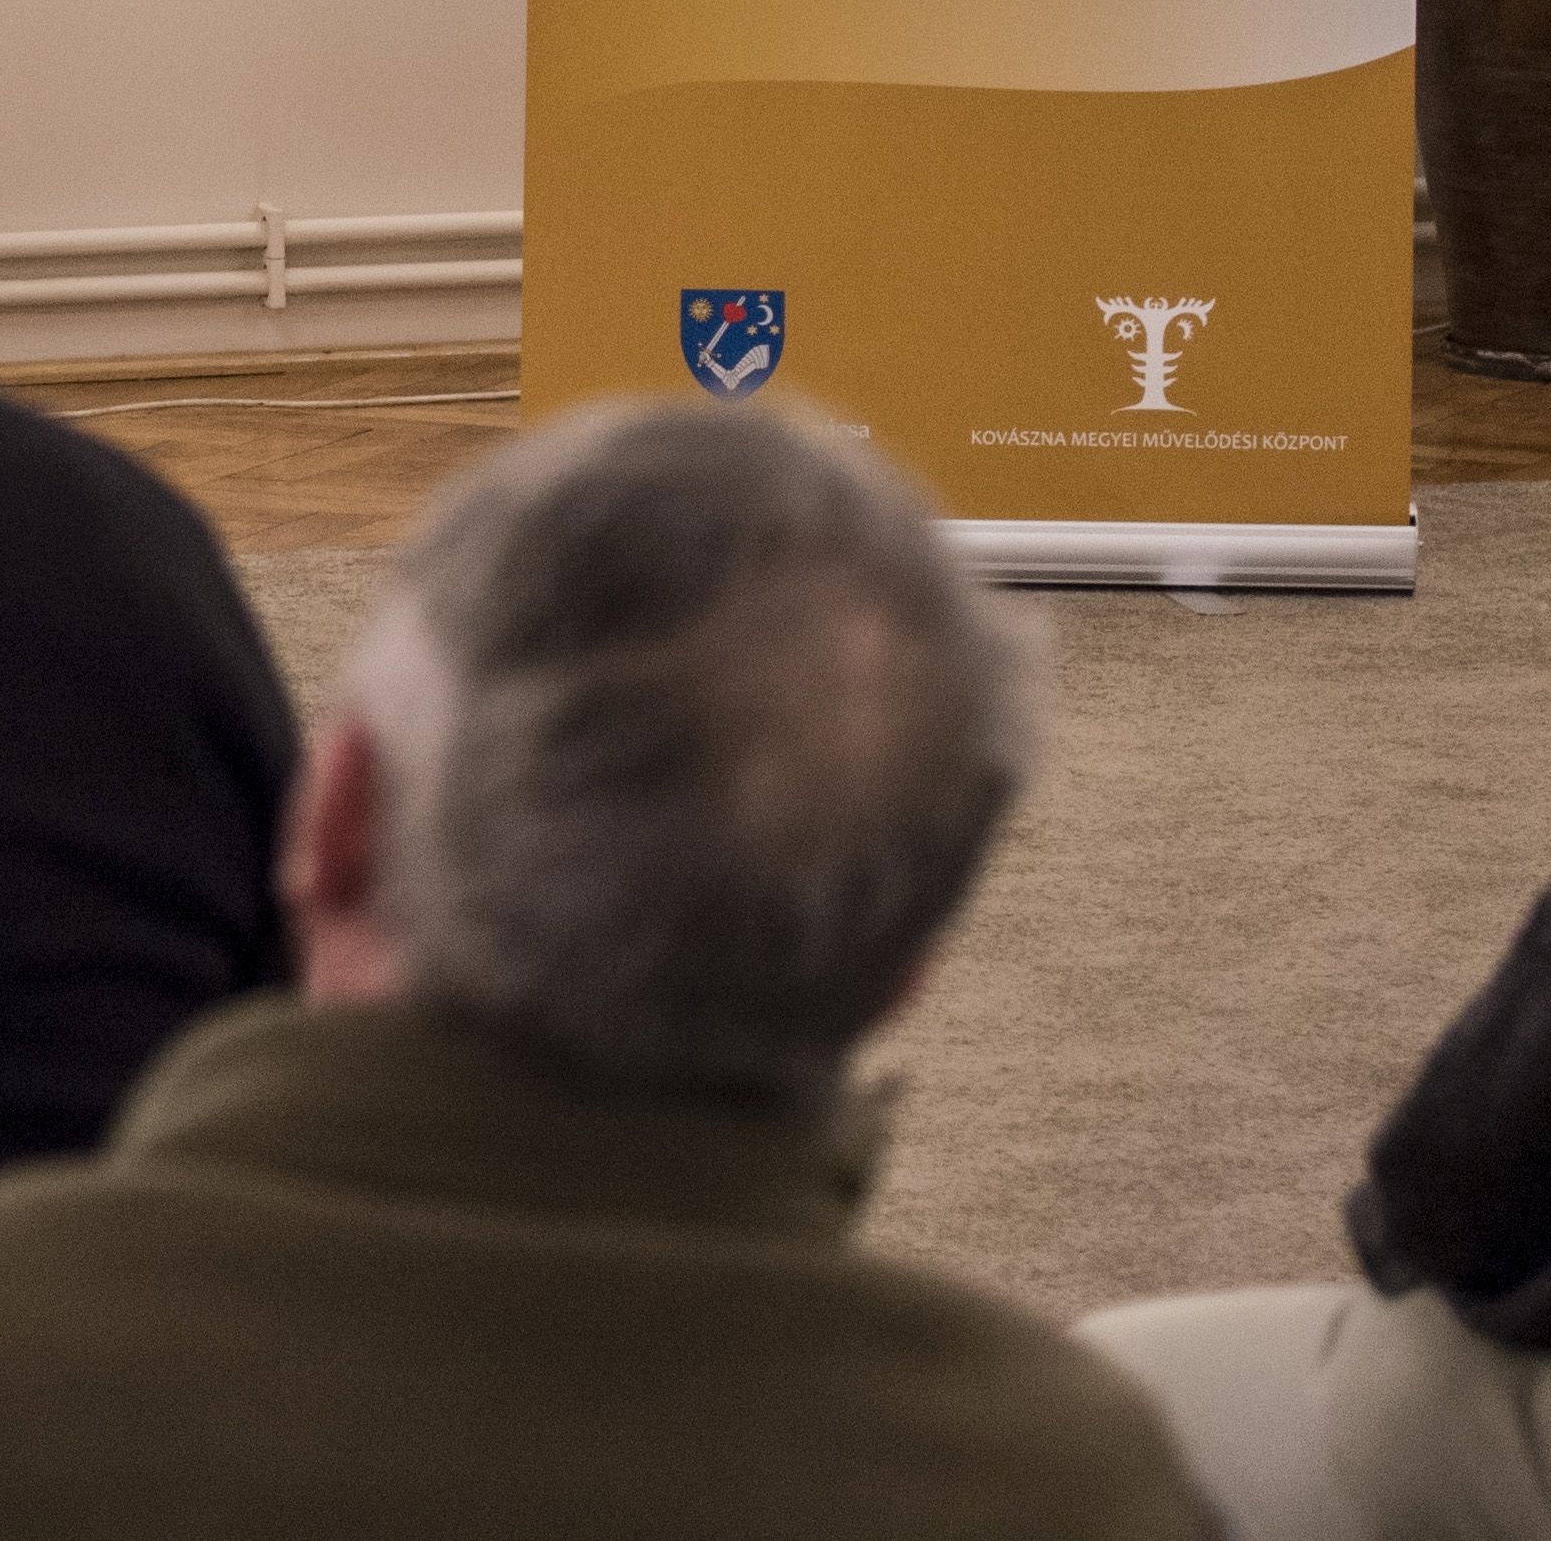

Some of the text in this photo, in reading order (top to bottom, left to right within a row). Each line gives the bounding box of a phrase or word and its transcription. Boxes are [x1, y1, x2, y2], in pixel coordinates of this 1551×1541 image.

[971, 427, 1348, 451] KOVÁSZNA MEGYEI MŰVELŐDÉSI KÖZPONT
